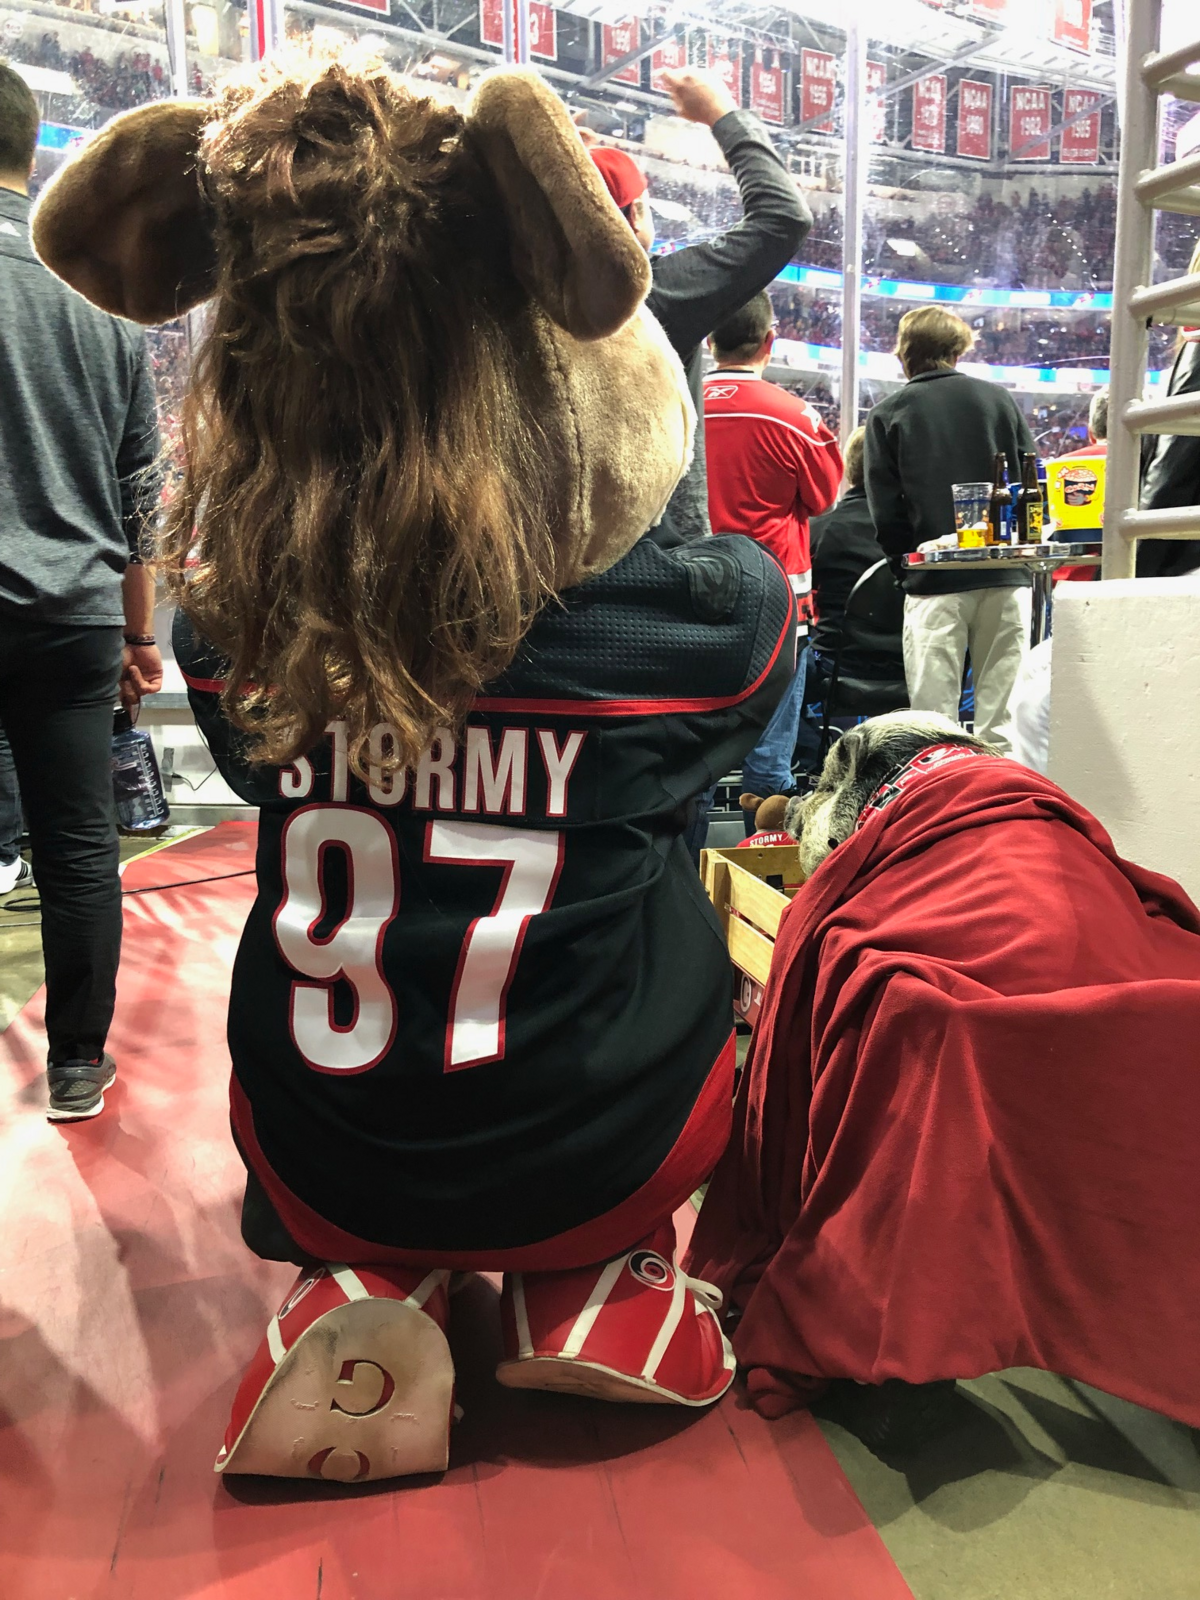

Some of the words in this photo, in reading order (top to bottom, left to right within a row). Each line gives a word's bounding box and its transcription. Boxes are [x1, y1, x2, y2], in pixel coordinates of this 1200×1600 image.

[963, 88, 988, 110] NCAA
[1015, 92, 1046, 111] NCAA
[750, 834, 783, 847] STORMY
[272, 803, 565, 1076] 97
